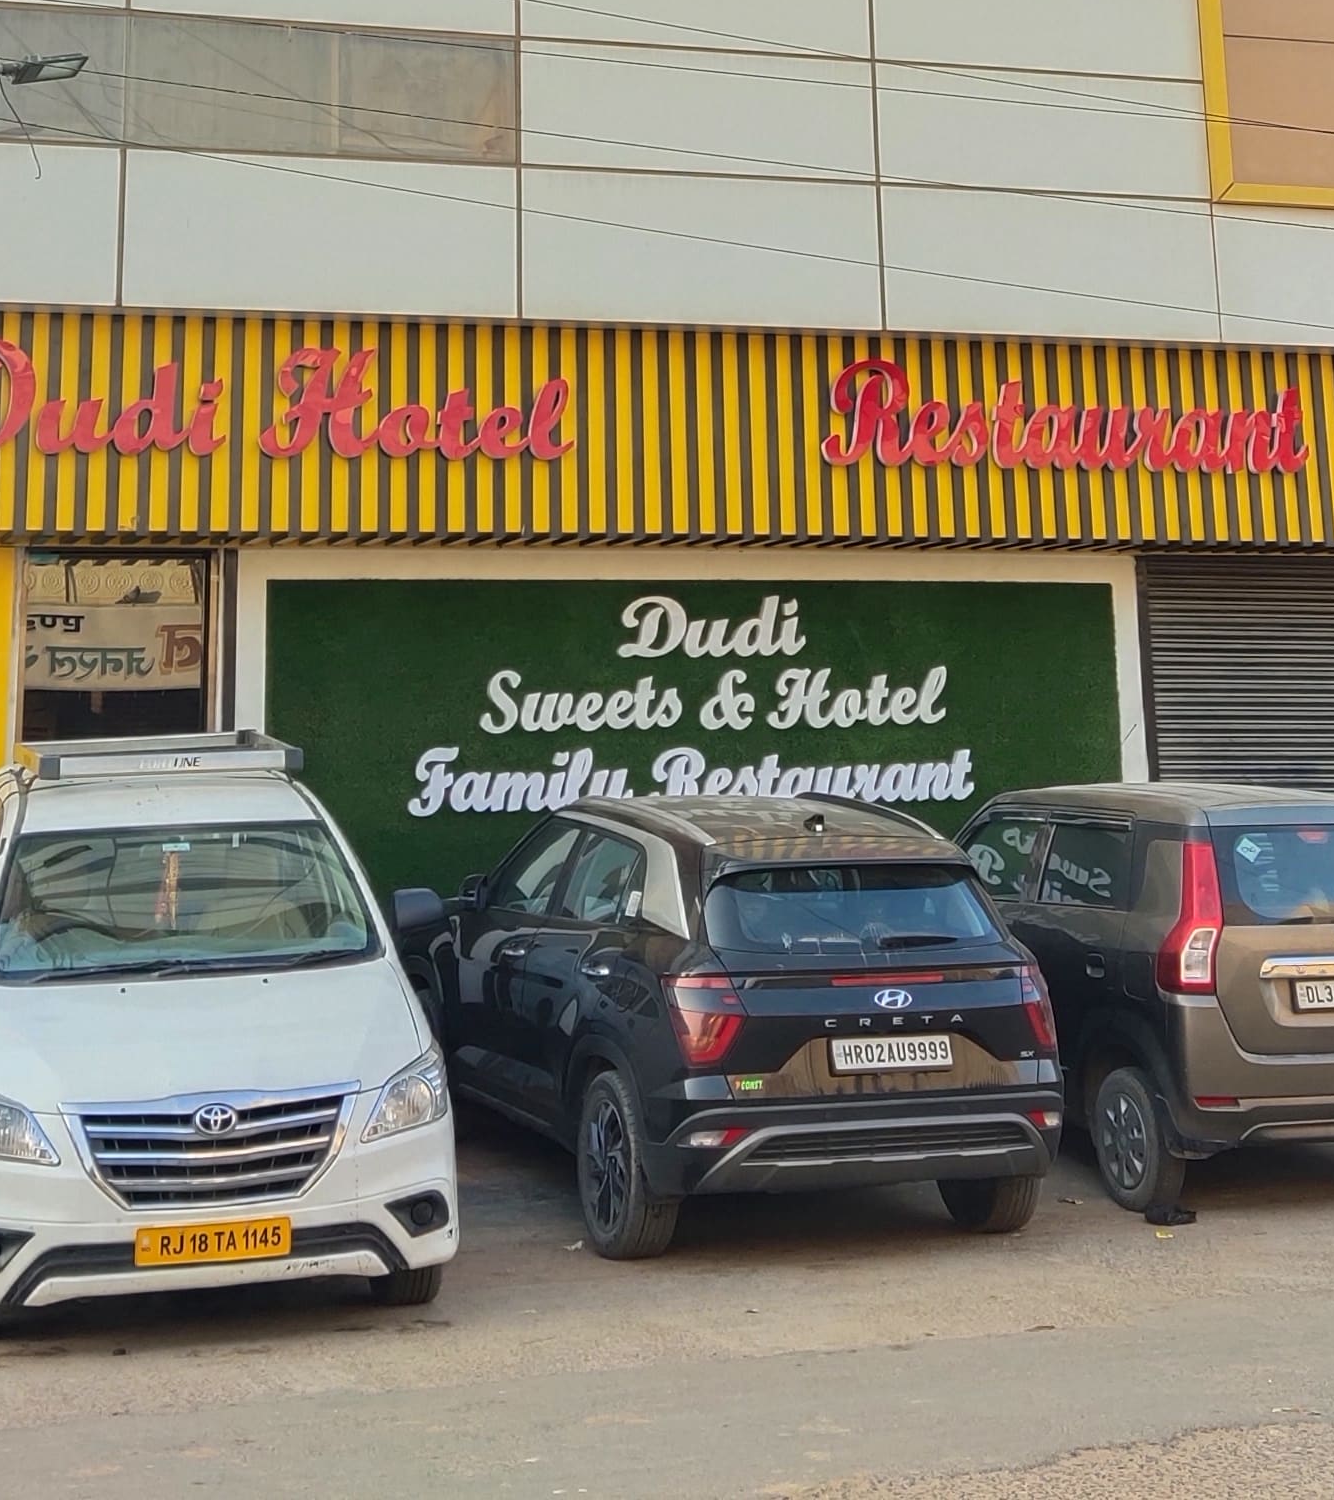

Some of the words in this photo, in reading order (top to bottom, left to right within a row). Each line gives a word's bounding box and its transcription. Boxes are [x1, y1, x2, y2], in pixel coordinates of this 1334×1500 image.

[258, 347, 576, 461] Hotel
[821, 358, 1311, 474] Restaurant
[616, 595, 806, 658] Dudi
[479, 669, 681, 734] Sweets
[698, 668, 755, 731] &
[766, 666, 948, 729] Hotel
[648, 747, 975, 803] Restaurant
[824, 1013, 964, 1028] CRETA
[843, 1040, 950, 1065] HR02AU9999
[160, 1232, 185, 1257] RJ
[191, 1230, 208, 1254] 18
[214, 1229, 238, 1253] TA
[242, 1226, 282, 1250] 1145
